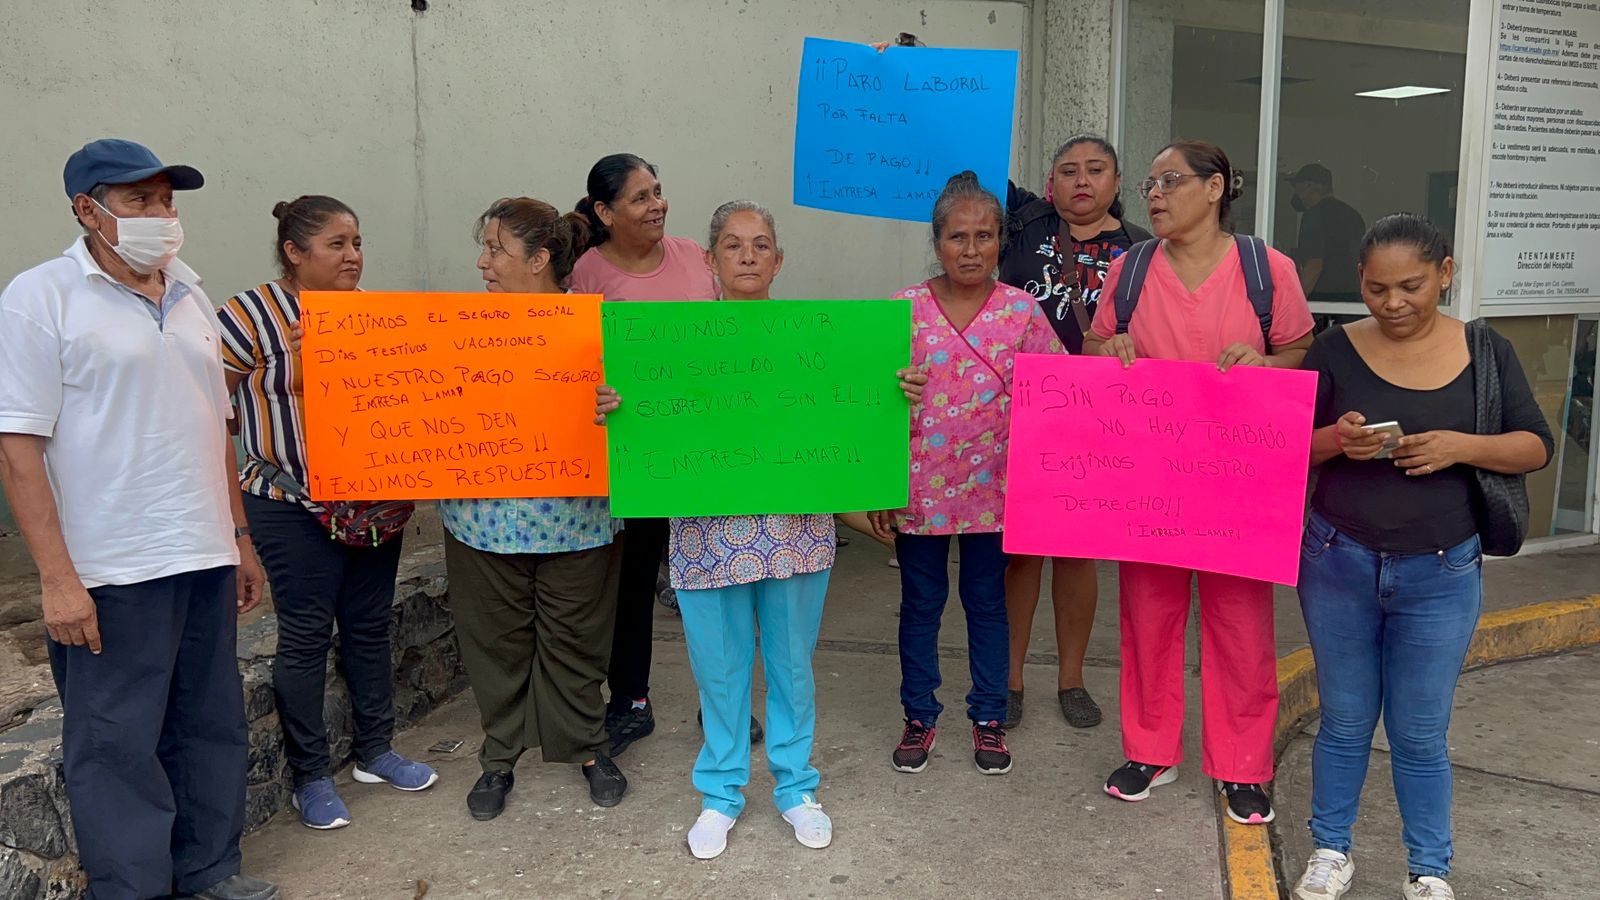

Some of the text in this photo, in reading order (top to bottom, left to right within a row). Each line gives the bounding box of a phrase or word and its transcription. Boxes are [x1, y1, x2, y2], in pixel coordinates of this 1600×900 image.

[817, 103, 908, 125] POR FALTA
[826, 149, 855, 165] DE
[1518, 252, 1575, 260] ATENTAMENTE
[1518, 261, 1542, 270] Dirección
[428, 313, 448, 322] EL
[459, 310, 510, 321] SEGURO
[527, 304, 575, 318] SOCIAL
[761, 312, 834, 333] VIVIR
[366, 342, 428, 356] FESTIVOS
[453, 334, 546, 350] VACASIONES
[633, 351, 826, 381] CON SUELDO NO
[342, 369, 444, 390] NUESTRO
[454, 366, 514, 384] PAGO
[533, 368, 600, 383] SEGURO
[635, 391, 759, 418] SOBREVIVIR
[777, 388, 817, 407] SIN
[1106, 383, 1175, 407] PAGO
[333, 412, 517, 446] Y QUE NOS DEN
[1097, 417, 1287, 450] NO HAY TRABAJO
[446, 458, 591, 487] RESPUESTAS!
[1163, 457, 1256, 478] NUESTRO
